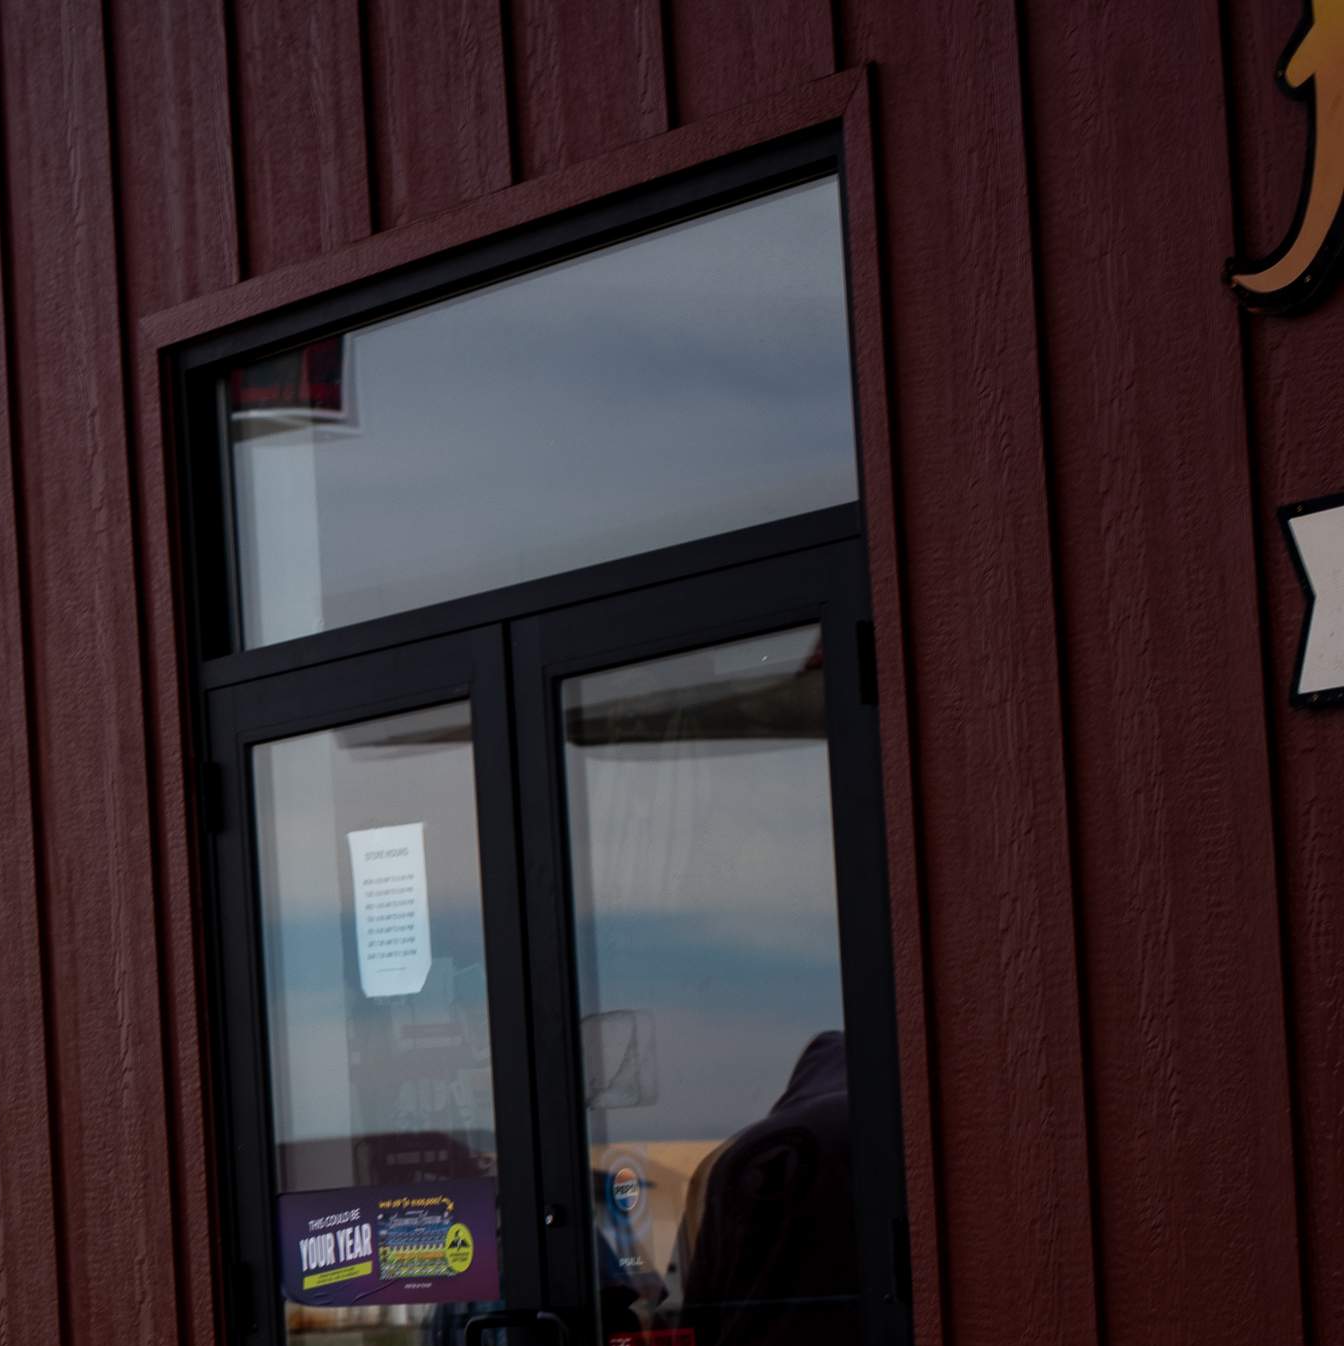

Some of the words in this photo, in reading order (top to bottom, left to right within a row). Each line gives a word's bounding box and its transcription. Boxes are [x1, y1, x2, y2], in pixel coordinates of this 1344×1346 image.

[308, 1217, 324, 1231] THIS
[350, 1208, 361, 1222] BE
[299, 1232, 336, 1272] YOUR
[336, 1223, 373, 1263] YEAR
